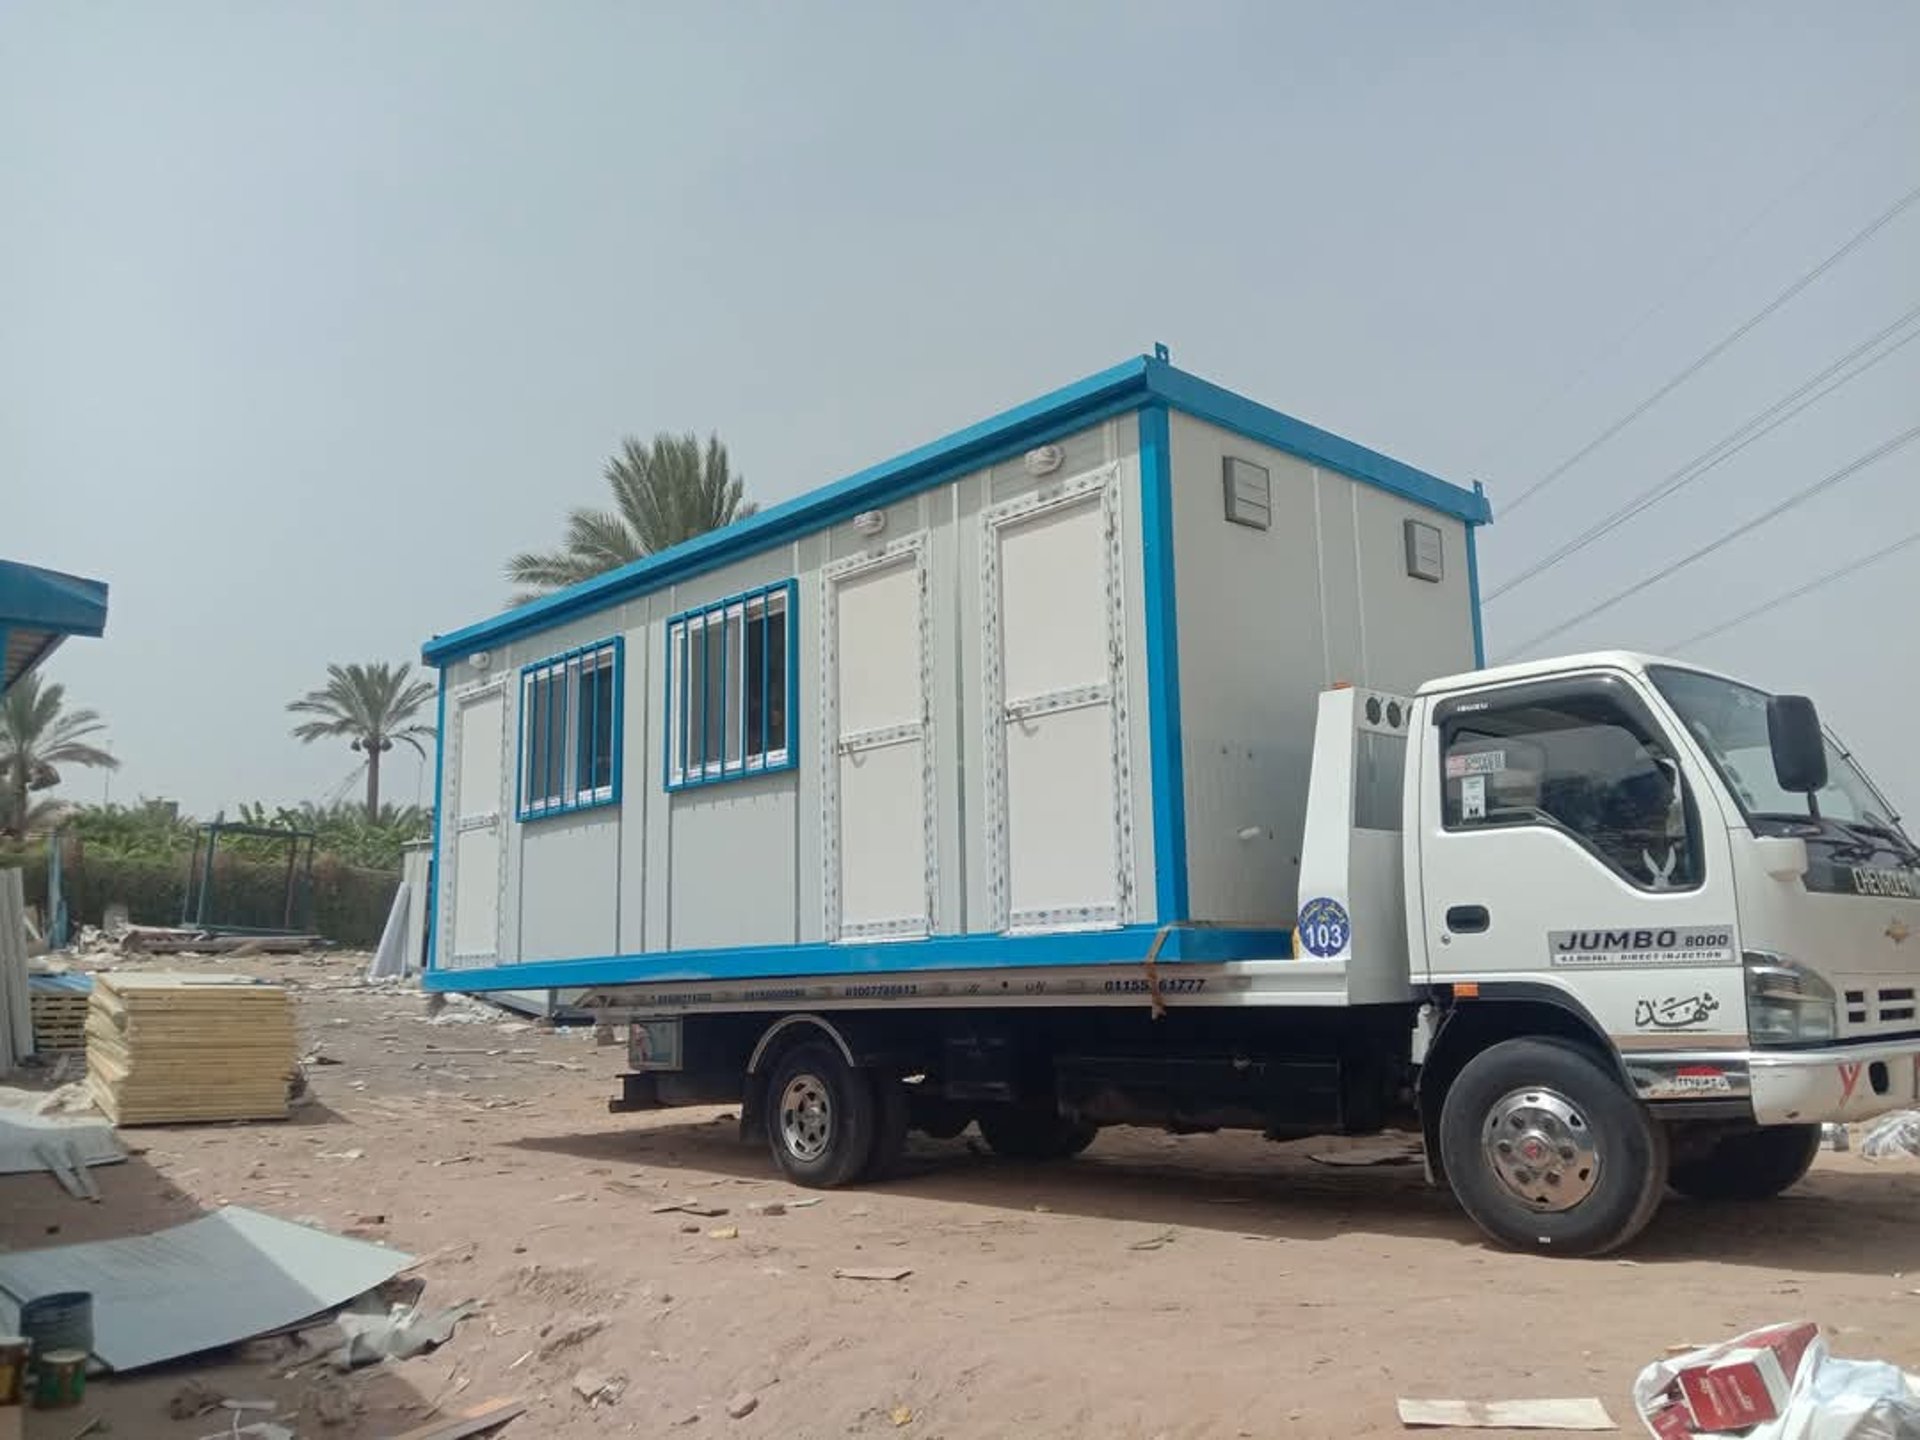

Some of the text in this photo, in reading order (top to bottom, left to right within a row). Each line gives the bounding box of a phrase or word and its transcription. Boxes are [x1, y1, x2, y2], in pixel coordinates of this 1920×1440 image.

[1305, 923, 1343, 949] 103
[1557, 929, 1730, 952] JUMBO 8000
[1620, 952, 1660, 961] DIRECT
[1661, 950, 1723, 960] INJECTION
[1104, 977, 1208, 994] 0115561777
